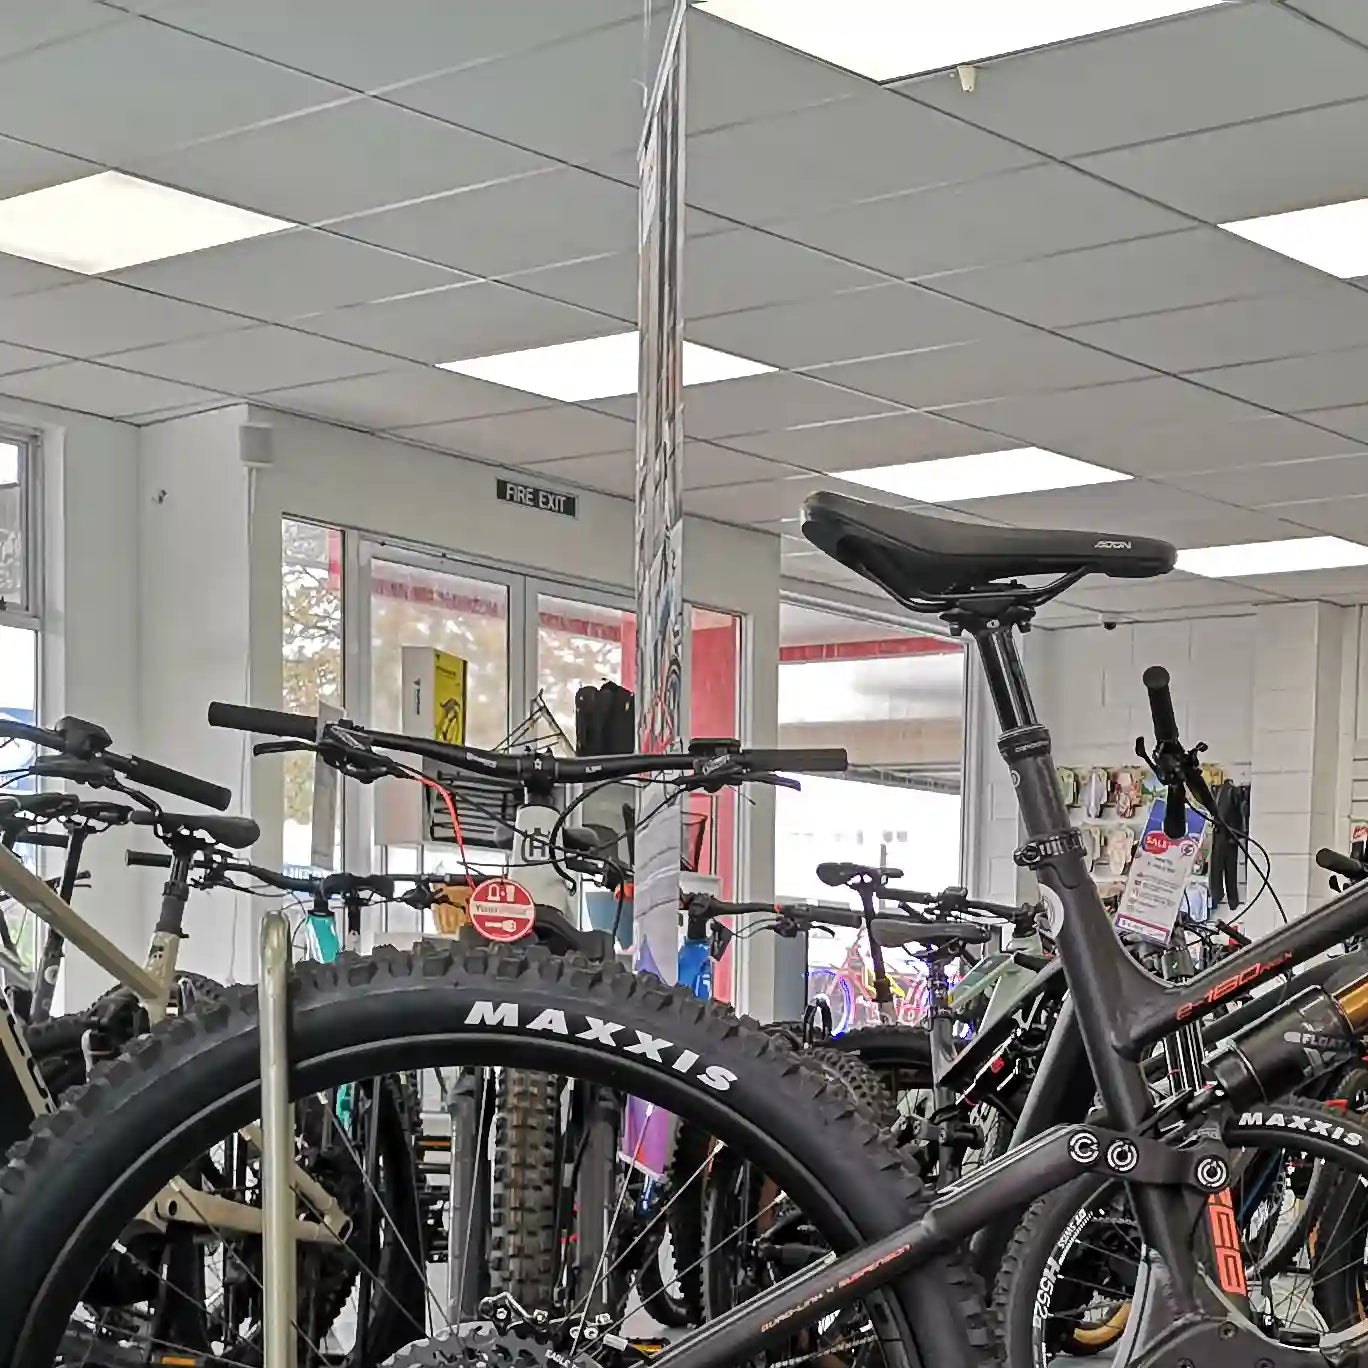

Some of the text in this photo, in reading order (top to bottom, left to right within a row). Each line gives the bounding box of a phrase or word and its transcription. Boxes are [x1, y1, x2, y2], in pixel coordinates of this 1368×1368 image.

[506, 483, 566, 513] FIRE EXIT
[1146, 835, 1168, 850] SALE
[464, 1001, 739, 1092] MAXXIS
[1239, 1111, 1364, 1147] MAXXIS
[545, 1349, 569, 1368] EAGLE
